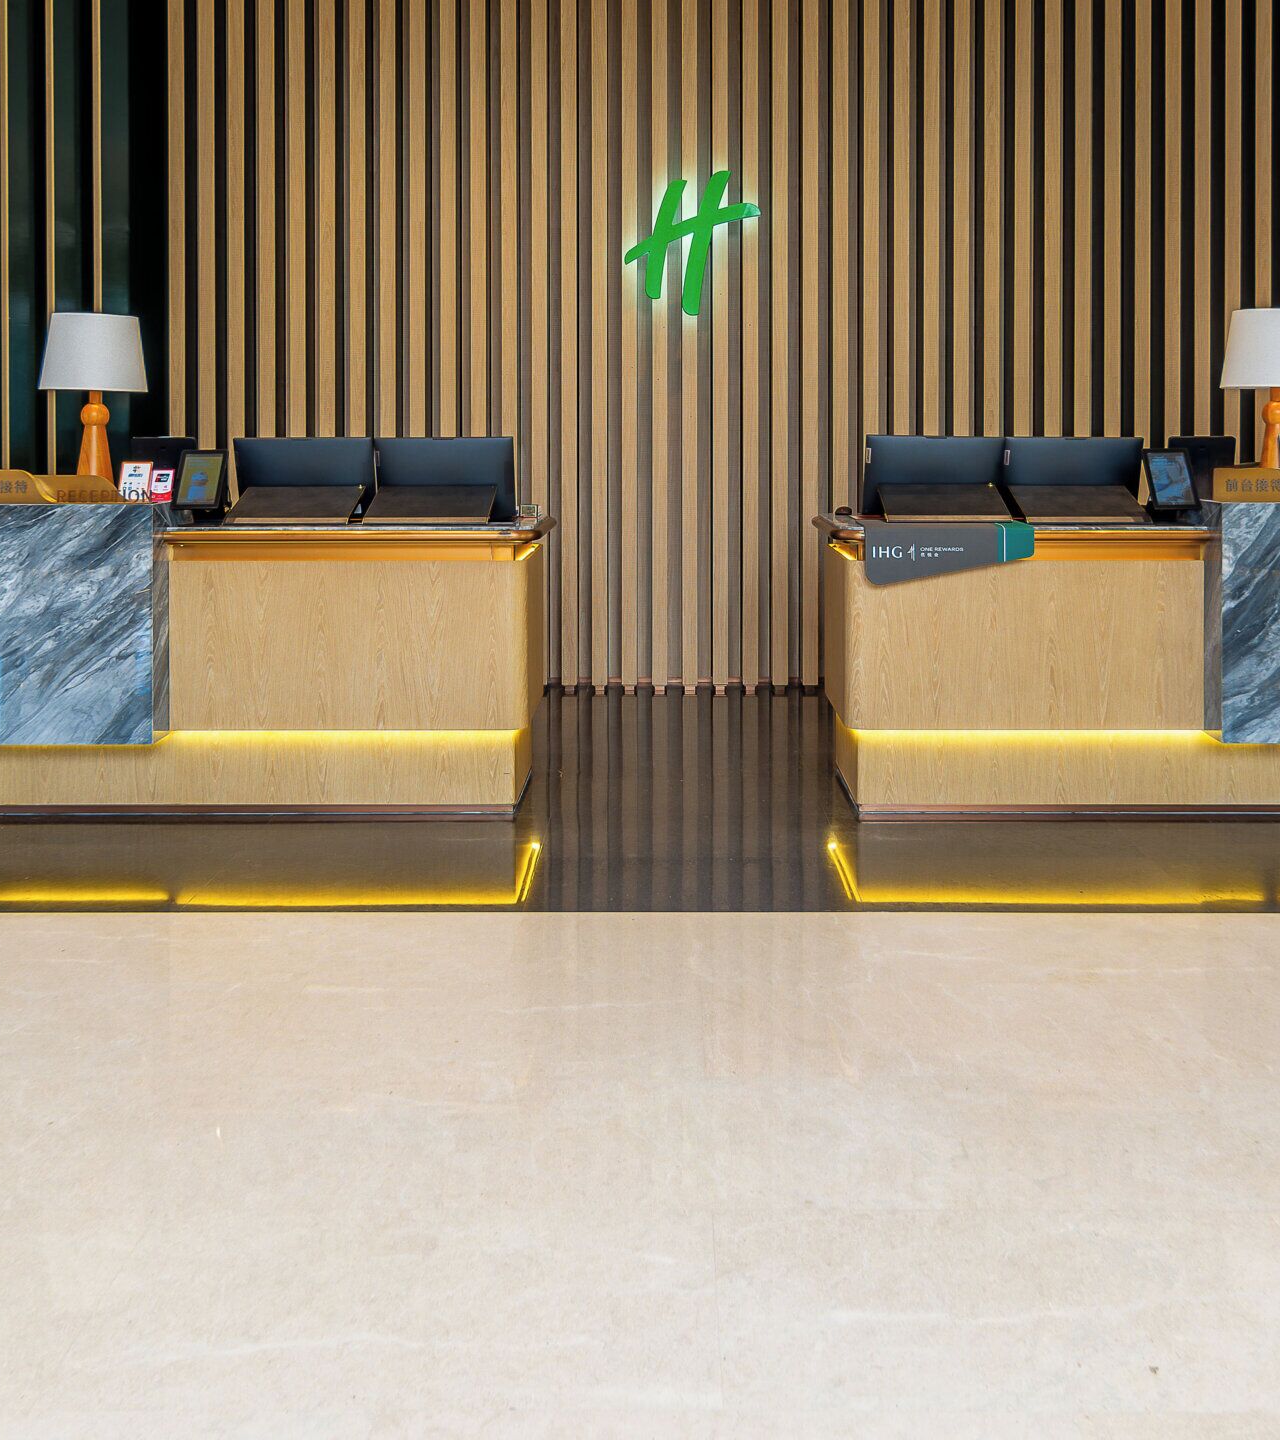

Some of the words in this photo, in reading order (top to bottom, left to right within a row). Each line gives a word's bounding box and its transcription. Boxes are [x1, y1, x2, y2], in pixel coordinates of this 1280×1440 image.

[624, 170, 762, 315] H
[57, 489, 153, 503] RECEPTION
[872, 545, 903, 559] IHG
